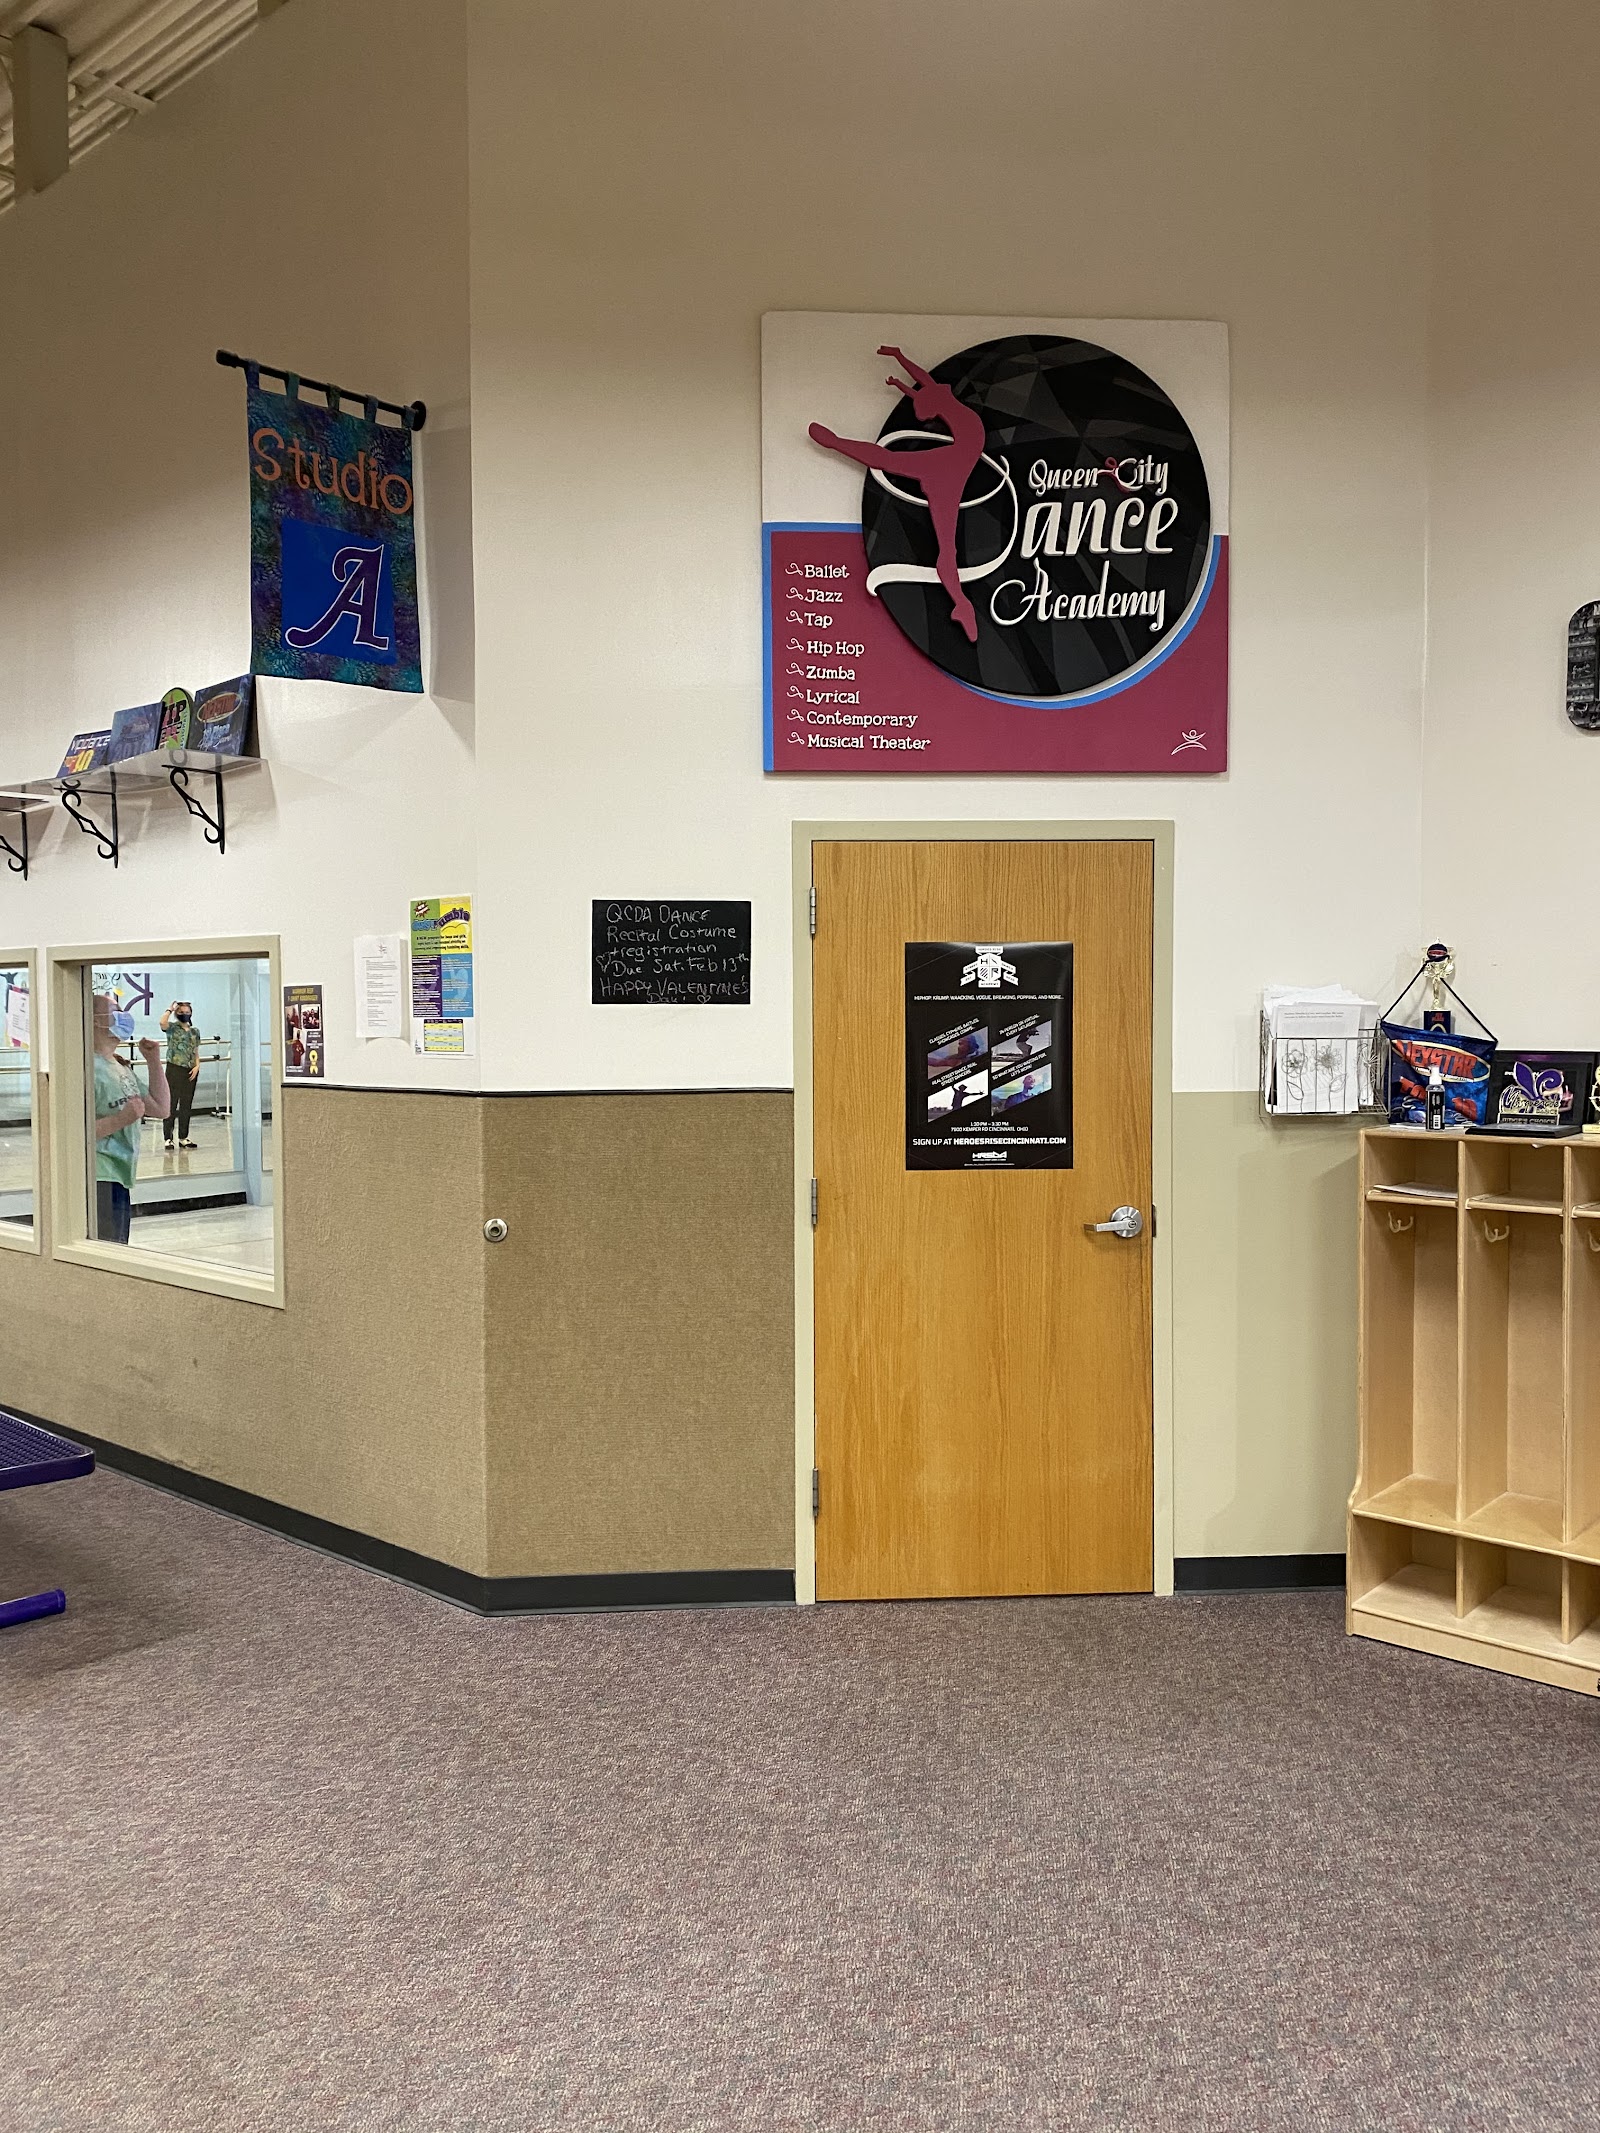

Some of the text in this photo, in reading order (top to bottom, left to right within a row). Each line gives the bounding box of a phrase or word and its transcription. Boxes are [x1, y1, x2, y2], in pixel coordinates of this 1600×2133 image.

[252, 427, 413, 515] Studio
[1028, 455, 1169, 497] Queen City
[804, 564, 850, 579] Ballet
[285, 544, 389, 650] A
[804, 588, 843, 604] Jazz
[989, 557, 1166, 631] Academy
[805, 612, 833, 628] Tap
[807, 640, 865, 657] Hip Hop
[806, 666, 856, 681] Zumba
[806, 690, 861, 706] Lyrical
[806, 711, 918, 728] Contemporary
[807, 734, 931, 751] Musical Theater
[606, 903, 711, 924] QCDA DANCE
[607, 923, 737, 943] Recital Costume
[611, 960, 642, 976] Due
[653, 959, 684, 973] Sat.
[687, 957, 717, 972] Feb
[600, 977, 652, 996] HAPPY
[954, 1137, 1066, 1145] HEROESRISECINCINNATI.COM
